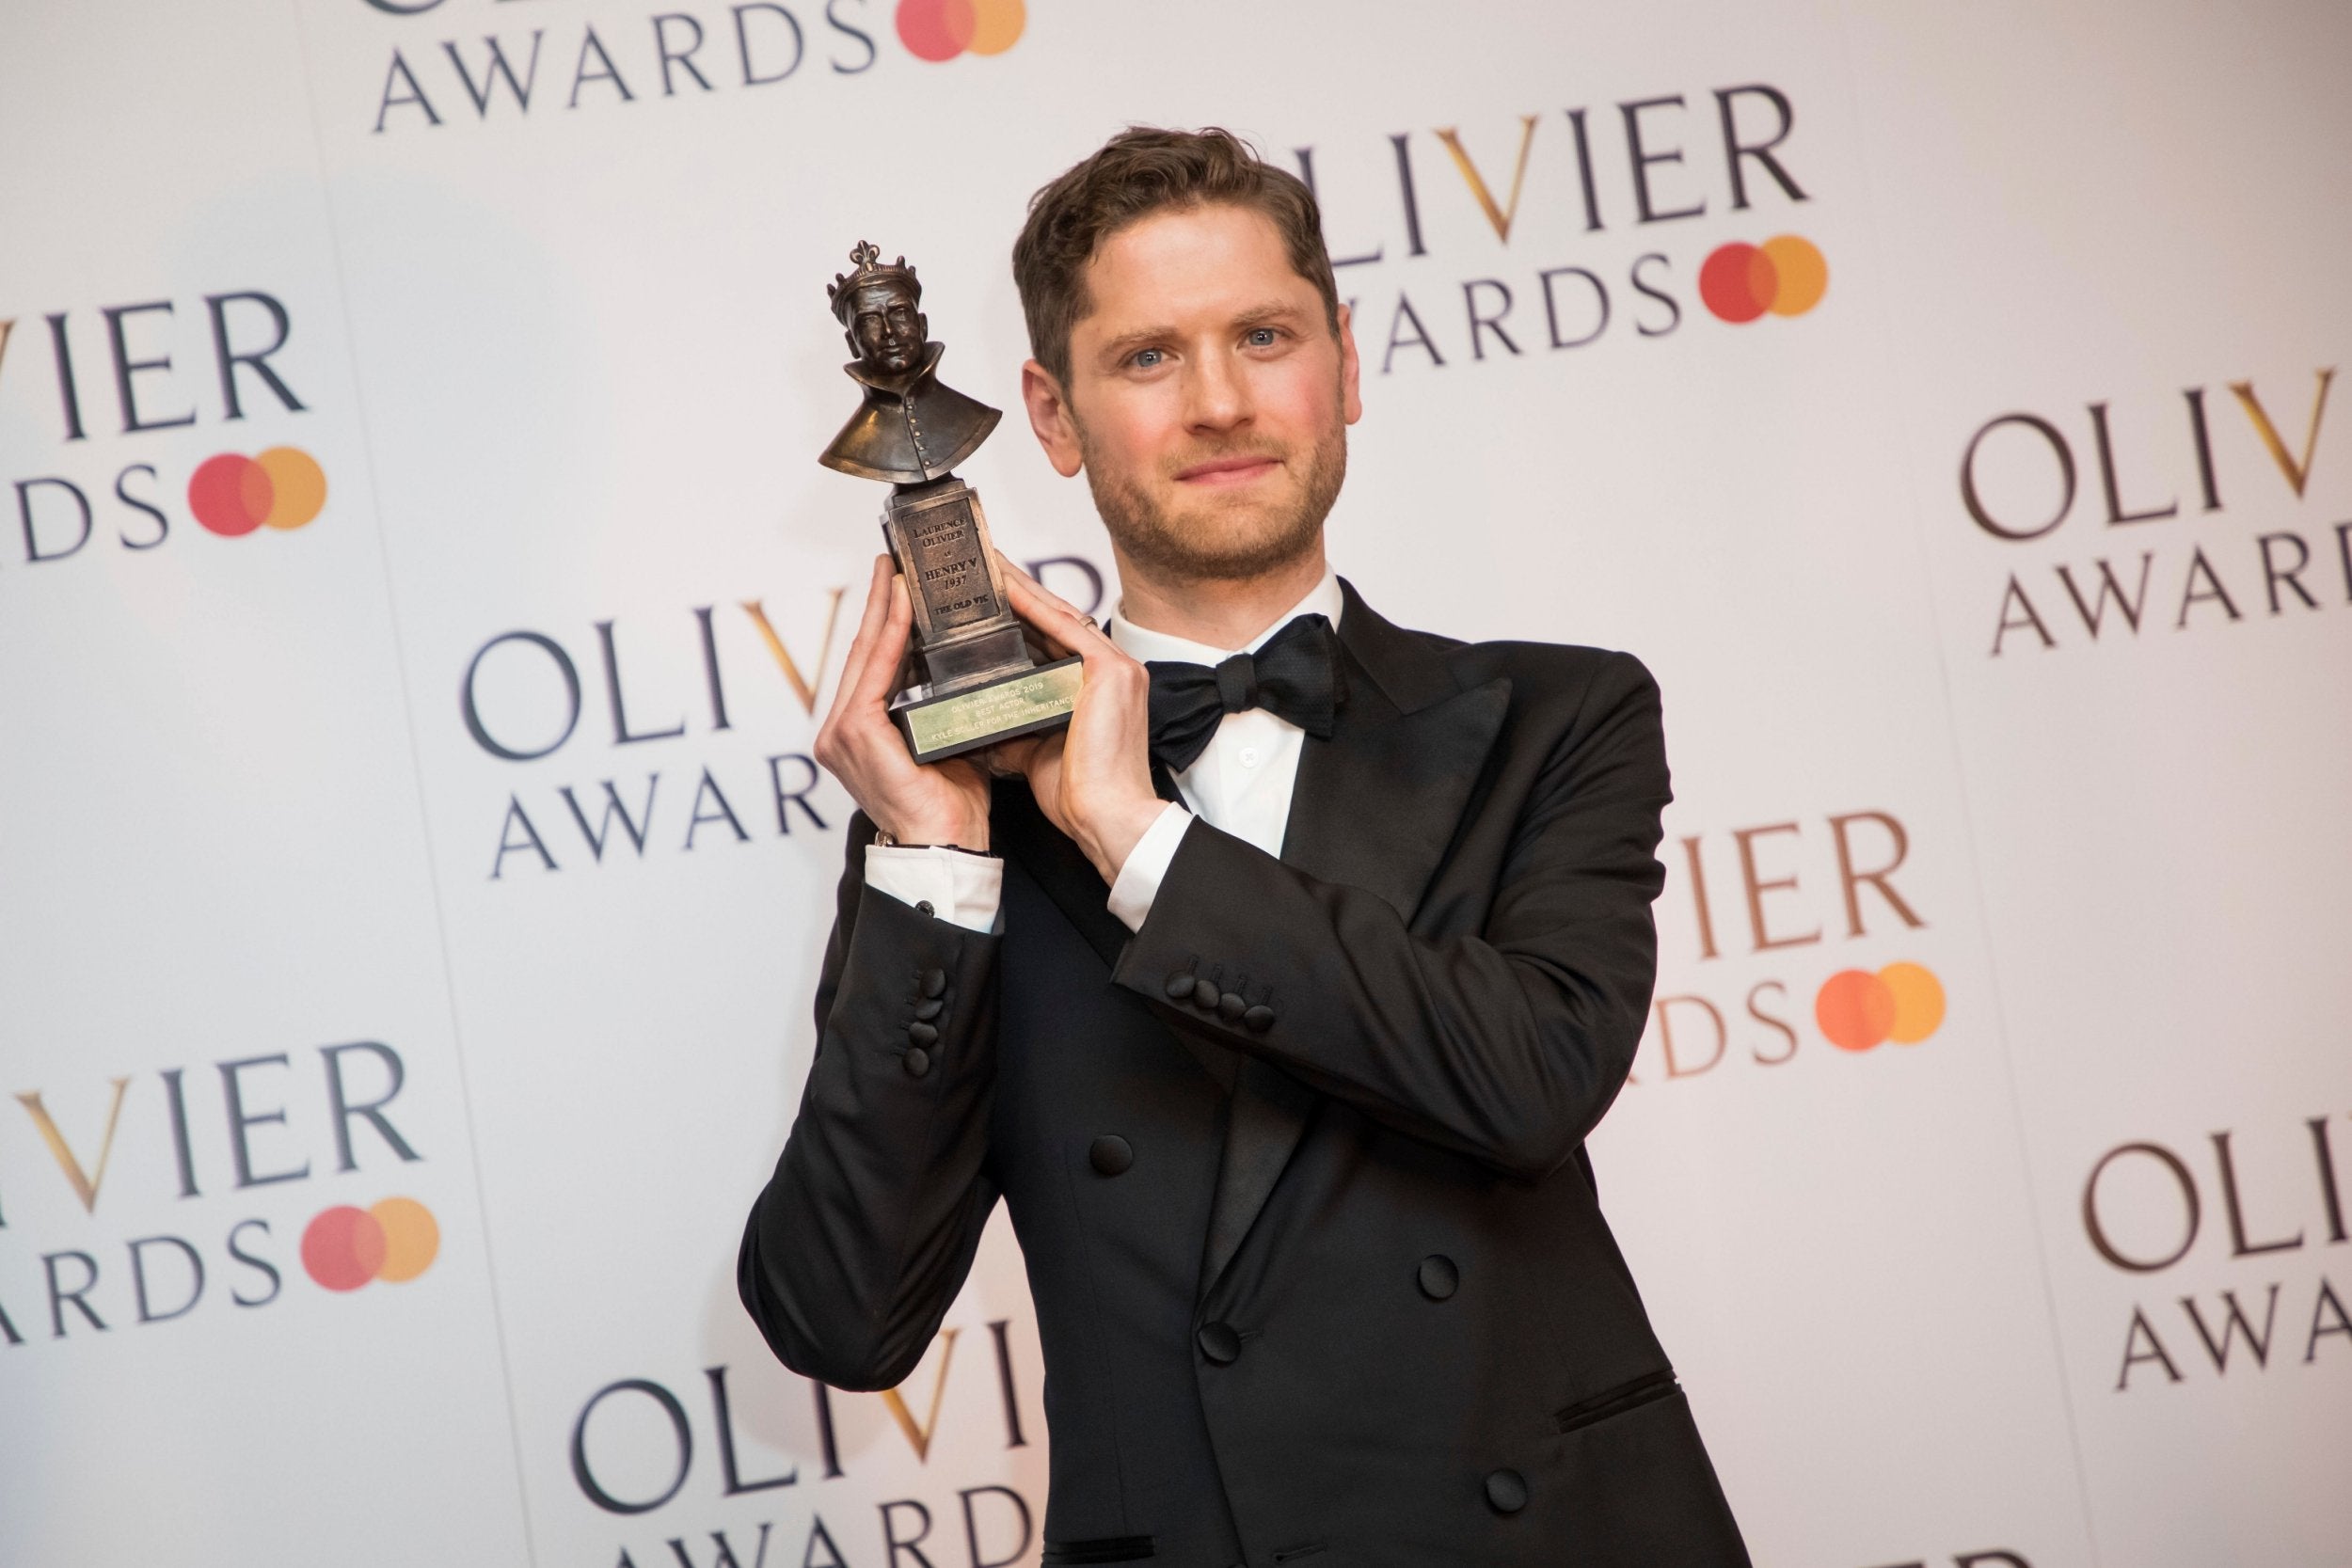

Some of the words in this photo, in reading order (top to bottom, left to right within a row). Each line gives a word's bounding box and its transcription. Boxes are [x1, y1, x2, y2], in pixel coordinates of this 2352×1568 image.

[372, 0, 876, 133] AWARDS
[1349, 252, 1682, 374] ARDS
[0, 292, 308, 442] IER
[1960, 365, 2337, 543] OLIV
[913, 518, 967, 539] LAURENCE
[922, 530, 964, 547] OLIVIER
[925, 561, 966, 581] HENRY
[968, 558, 977, 568] V
[945, 576, 967, 590] 1937
[1991, 522, 2352, 657] AWAR
[954, 599, 972, 610] OLD
[931, 730, 952, 741] KYLE
[987, 717, 1001, 727] FOR
[1003, 711, 1019, 722] THE
[1022, 695, 1075, 718] INHERITANCE
[951, 697, 985, 714] OLIVIER
[988, 689, 1021, 704] AWARDS
[1024, 682, 1044, 693] 2019
[976, 706, 995, 718] BEST
[999, 697, 1025, 710] ACTOR
[1626, 980, 1799, 1085] DS
[0, 1040, 426, 1228] VIER
[610, 1485, 1033, 1568] ARD
